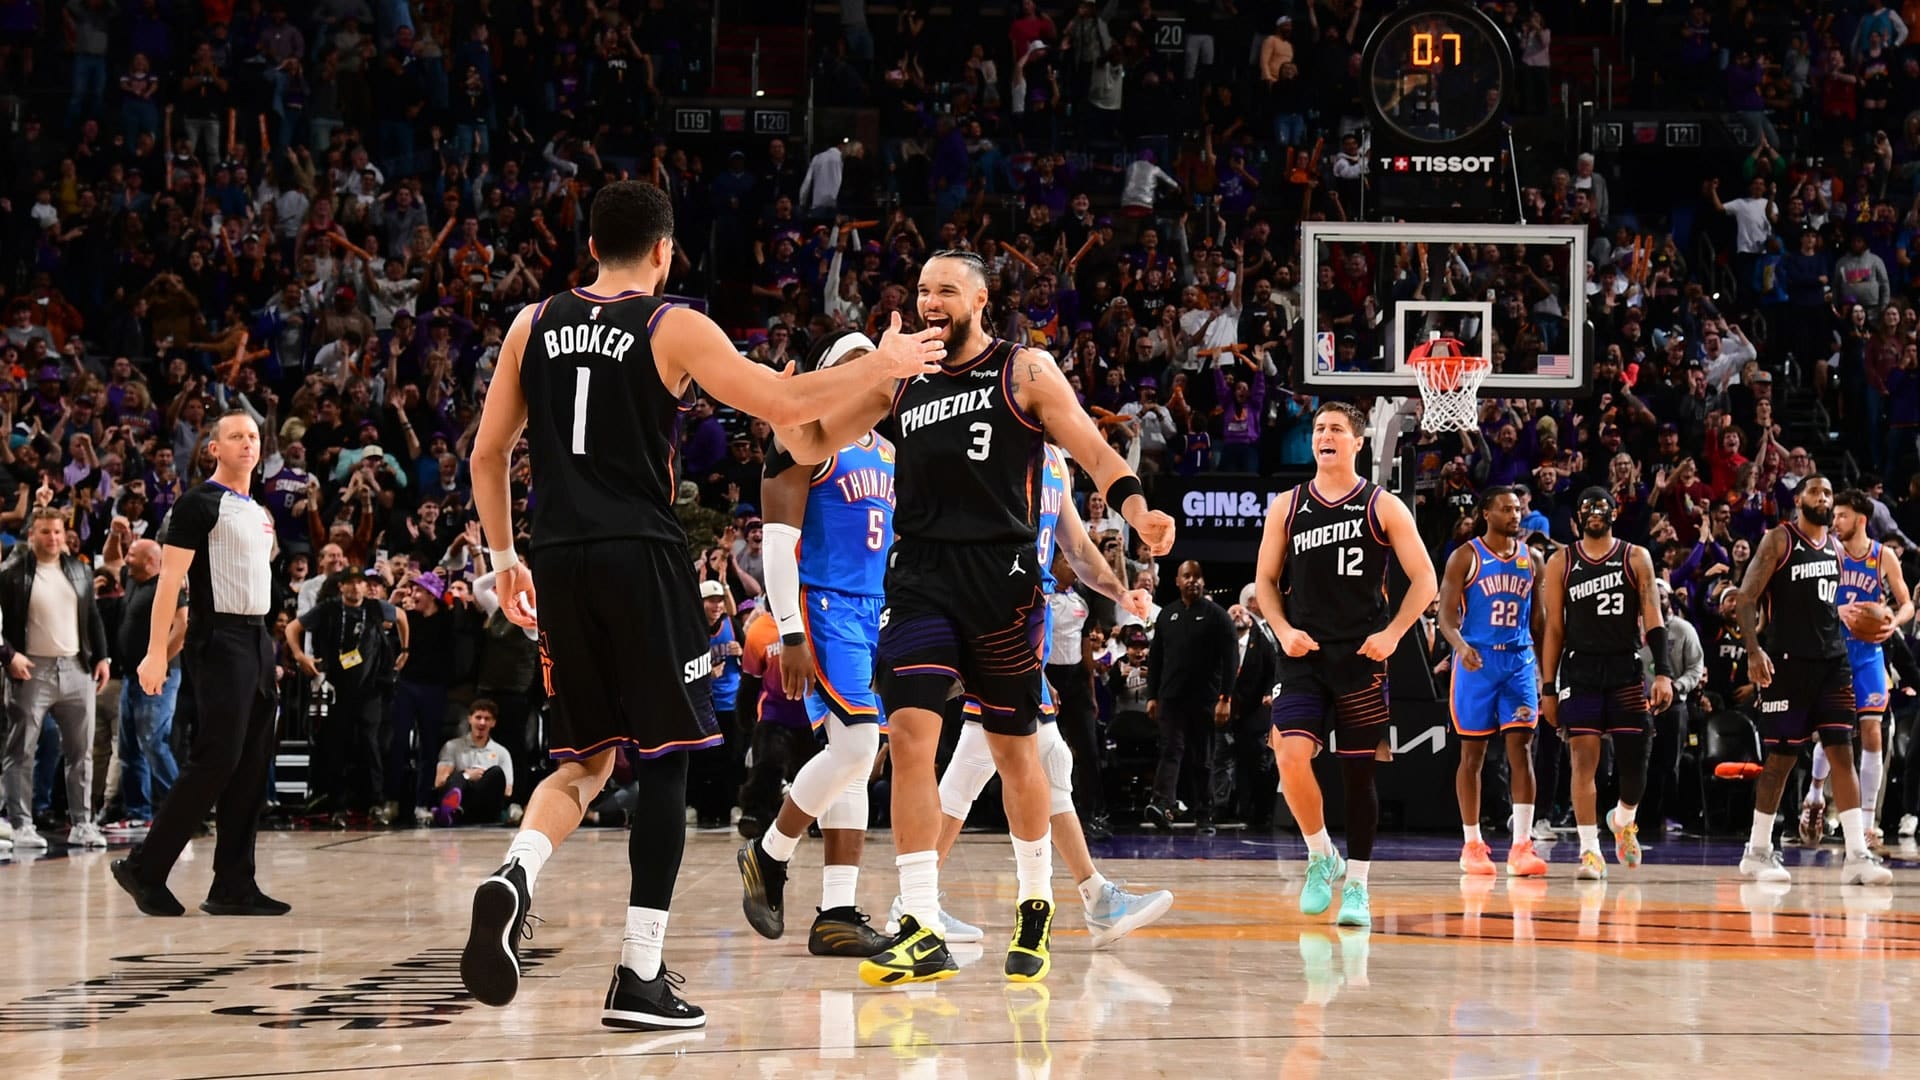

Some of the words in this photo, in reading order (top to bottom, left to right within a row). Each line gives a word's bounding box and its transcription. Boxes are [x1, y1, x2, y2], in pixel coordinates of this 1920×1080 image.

[1413, 33, 1462, 66] 0.7
[683, 113, 705, 129] 119
[760, 114, 785, 130] 120
[1673, 128, 1695, 143] 121
[1411, 156, 1495, 173] TISSOT
[543, 324, 635, 362] BOOKER
[970, 369, 999, 379] PayPal
[572, 366, 591, 455] 1
[900, 385, 995, 439] PHOENIX
[966, 421, 993, 462] 3
[836, 469, 896, 510] THUNDE
[1182, 491, 1283, 517] GIN&J
[866, 508, 885, 552] 5
[1186, 519, 1204, 527] BY
[1214, 519, 1245, 527] DRE
[1293, 518, 1364, 556] PHOENIX
[1337, 547, 1363, 576] 12
[1791, 560, 1839, 582] PHOENIX
[1478, 574, 1532, 599] THUNDER
[1569, 570, 1624, 602] PHOENIX
[1818, 578, 1837, 603] 00
[1490, 600, 1518, 627] 22
[1596, 593, 1625, 616] 23
[684, 650, 712, 684] SUN
